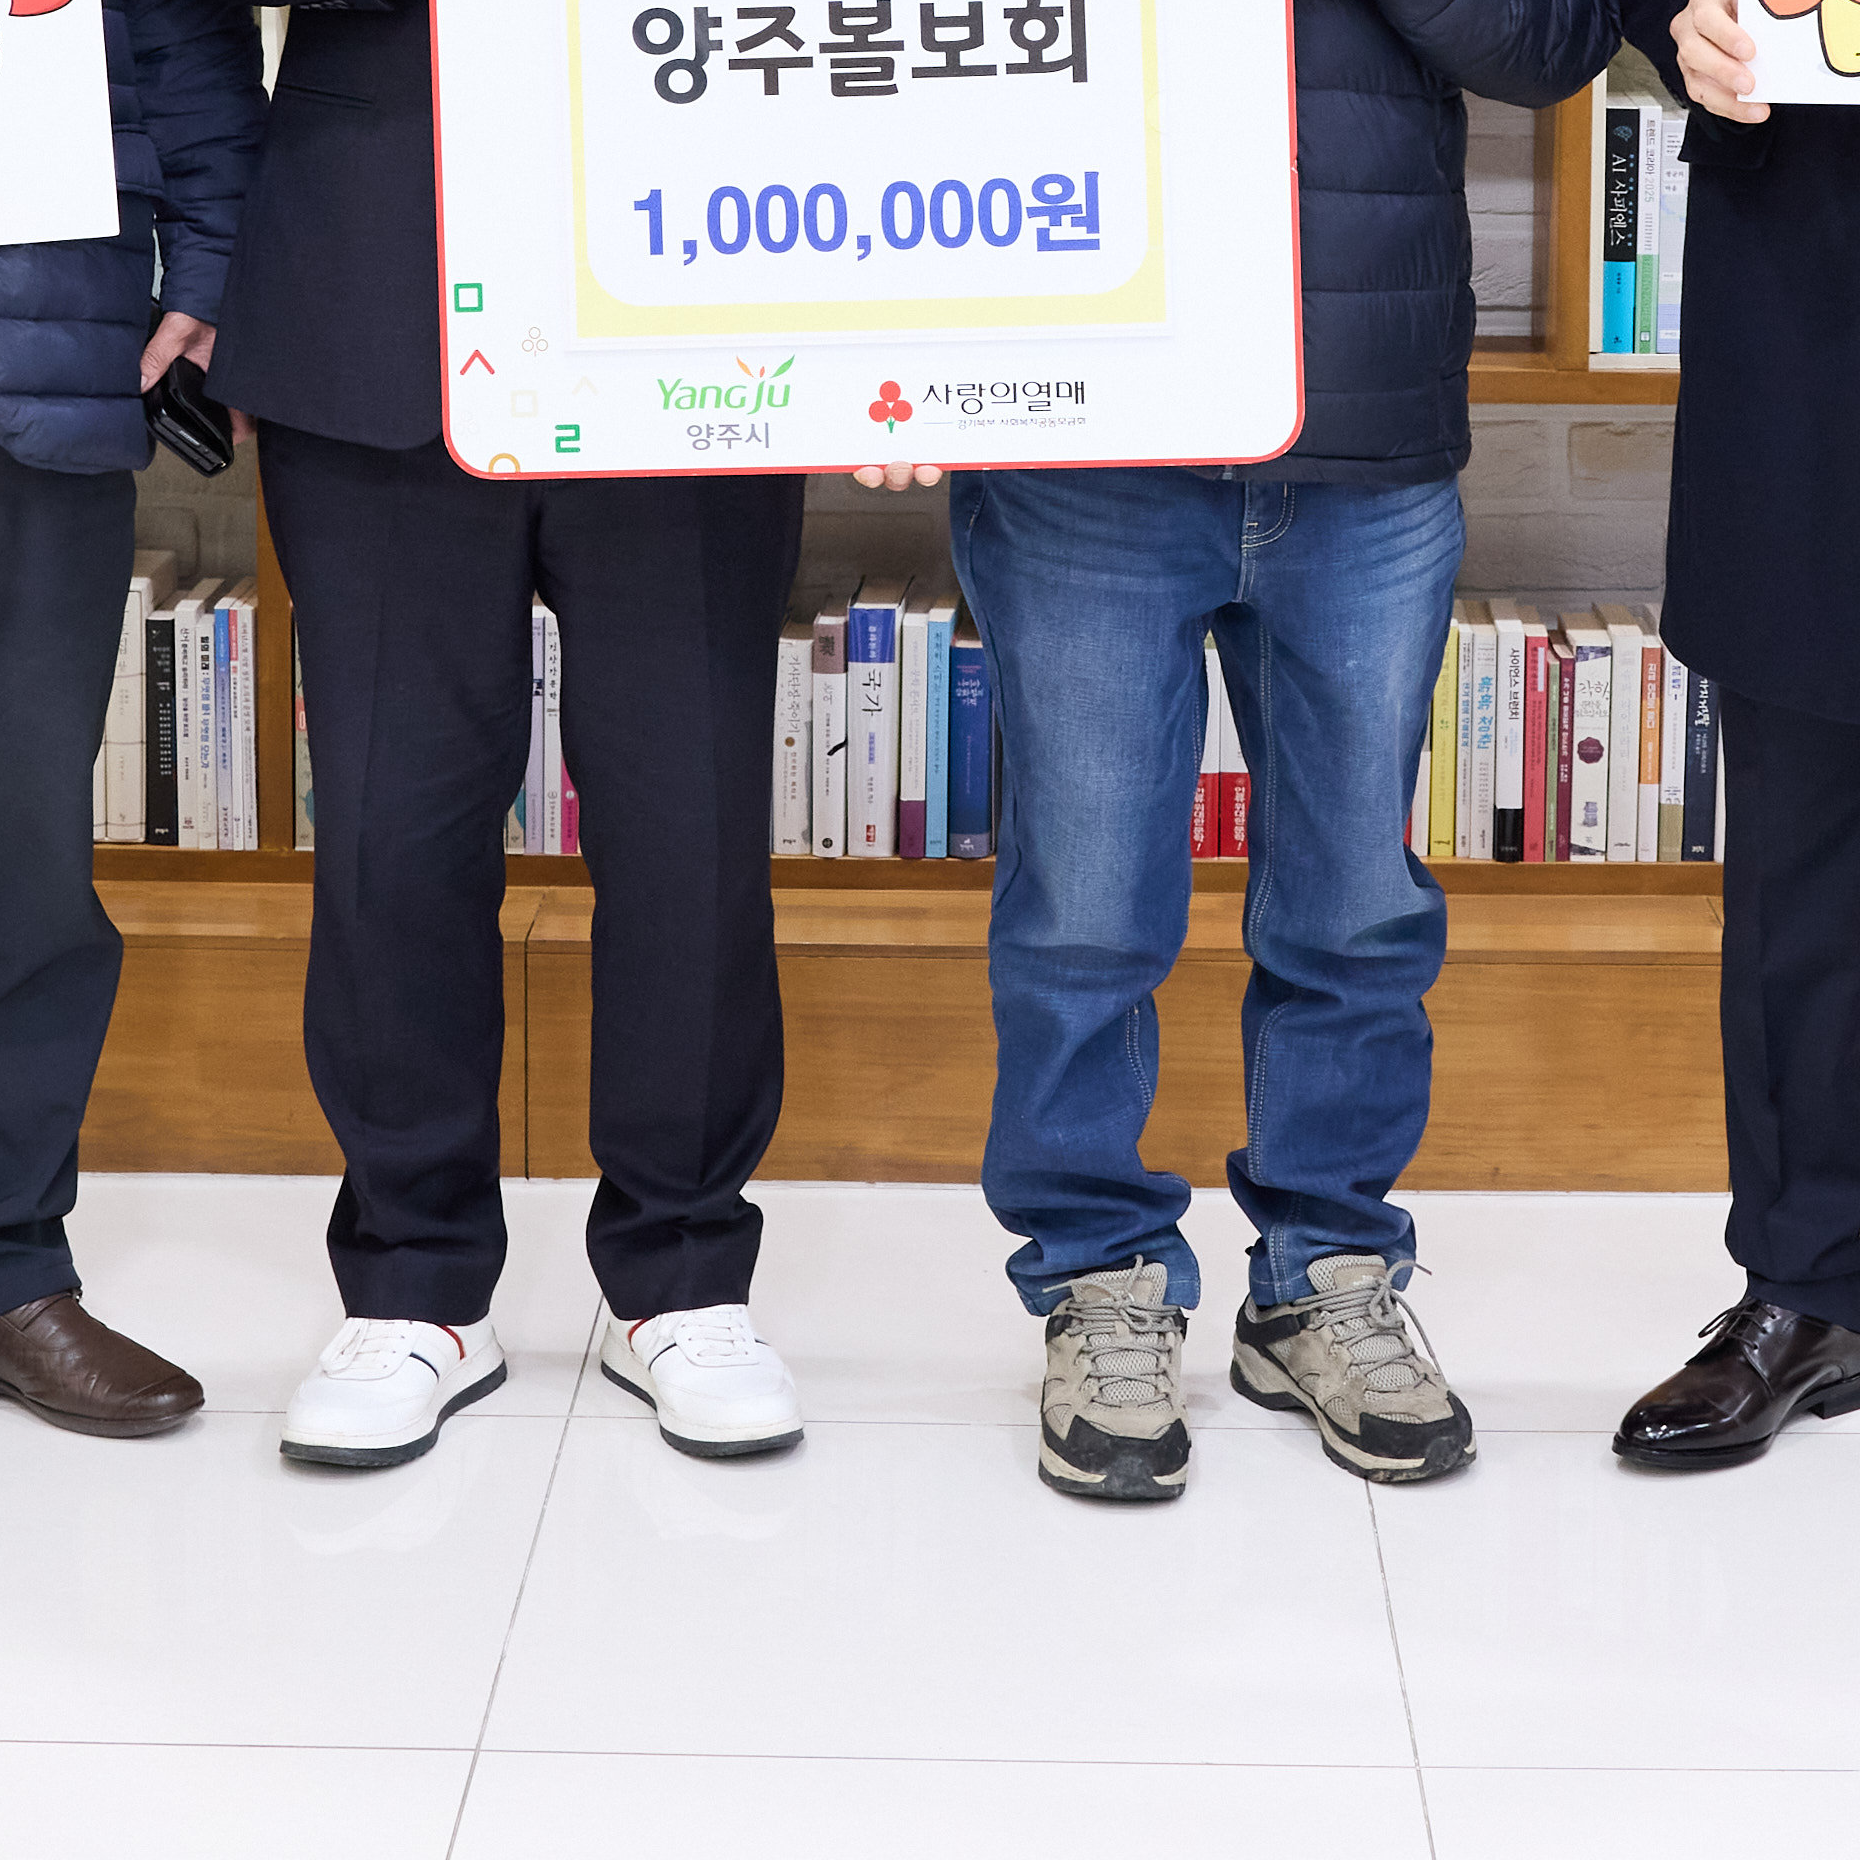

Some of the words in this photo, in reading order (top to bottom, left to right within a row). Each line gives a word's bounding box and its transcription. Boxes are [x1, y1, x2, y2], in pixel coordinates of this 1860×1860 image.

[1645, 118, 1656, 146] 트렌드
[1611, 153, 1628, 174] AI
[1645, 148, 1655, 175] 코리아
[1644, 177, 1654, 204] 2025
[633, 171, 1103, 267] 1,000,000원
[1609, 178, 1627, 247] 사피엔스
[922, 380, 1086, 415] 사랑의열매
[686, 421, 772, 451] 양주시
[788, 654, 801, 698] 기사단장
[1508, 647, 1521, 689] 사이언스
[861, 668, 883, 717] 국가
[1508, 690, 1521, 721] 브런치
[788, 699, 801, 733] 죽이기
